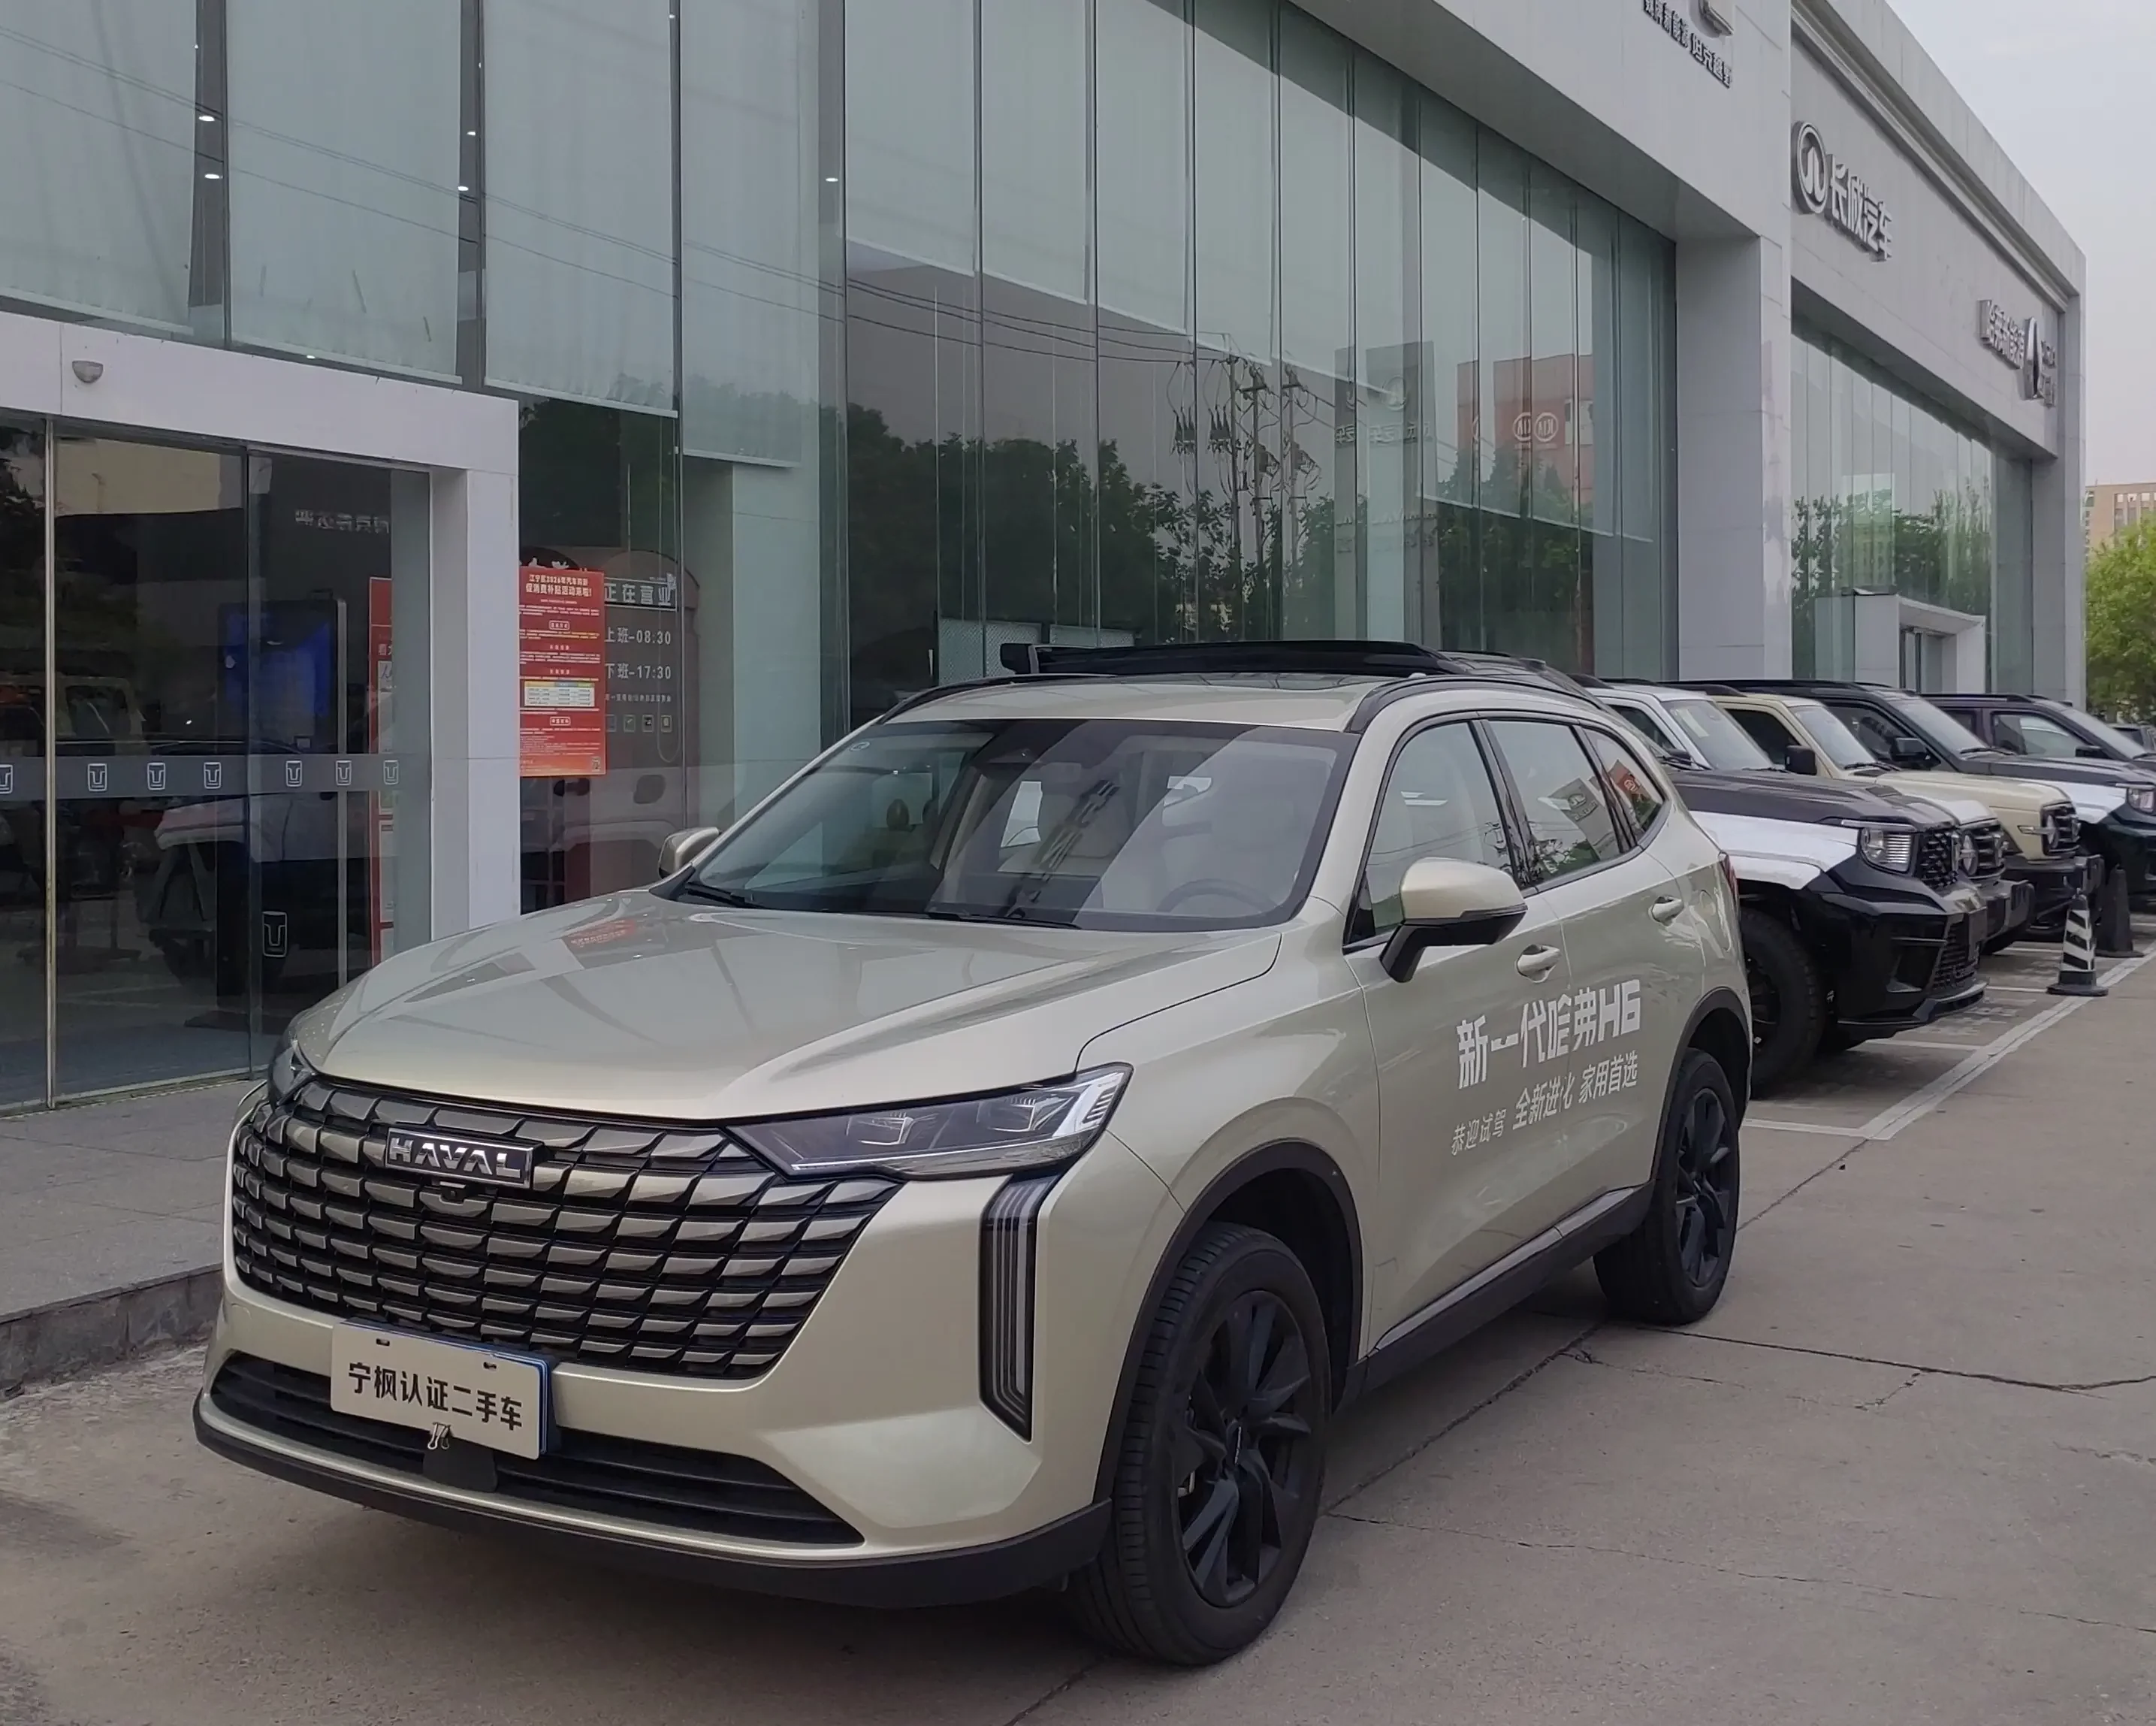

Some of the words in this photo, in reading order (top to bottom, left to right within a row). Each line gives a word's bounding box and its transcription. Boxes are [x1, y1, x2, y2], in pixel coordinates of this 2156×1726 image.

[1828, 154, 1892, 260] 长城汽车
[604, 582, 672, 606] 正在营业
[605, 627, 671, 645] 上班-08:30
[605, 663, 671, 680] 下班-17:30
[1456, 979, 1641, 1090] 新一代哈弗H6
[1451, 1108, 1507, 1156] 恭迎试驾
[1512, 1072, 1575, 1130] 全新进化
[1578, 1049, 1638, 1104] 家用首选
[388, 1136, 522, 1179] HAVAL
[348, 1362, 523, 1431] 宁枫认证二手车
